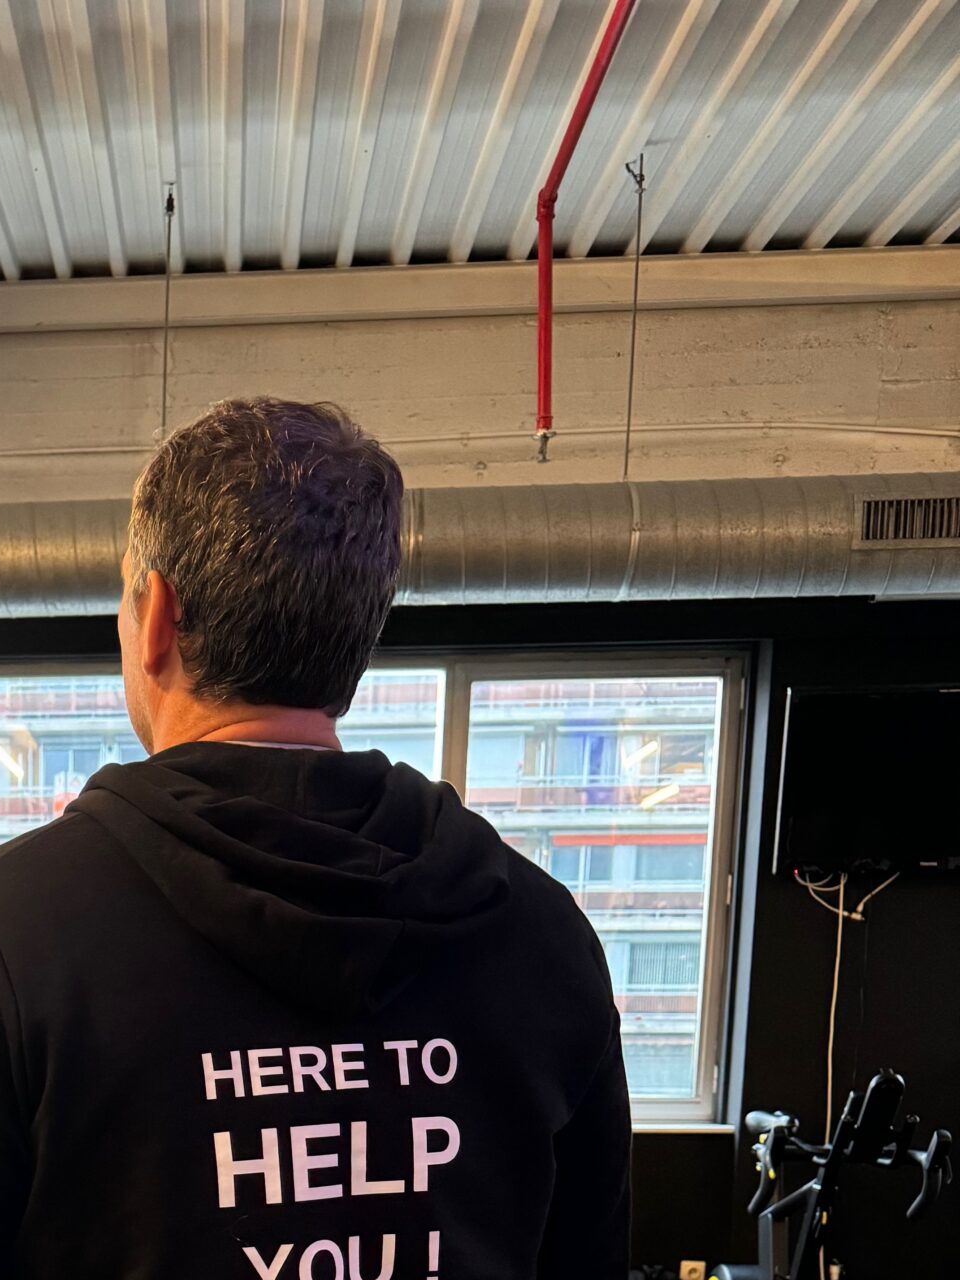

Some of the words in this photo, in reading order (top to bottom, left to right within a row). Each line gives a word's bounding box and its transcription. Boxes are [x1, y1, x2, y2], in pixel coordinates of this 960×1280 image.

[201, 1043, 370, 1100] HERE
[383, 1037, 459, 1086] TO
[212, 1115, 461, 1209] HELP
